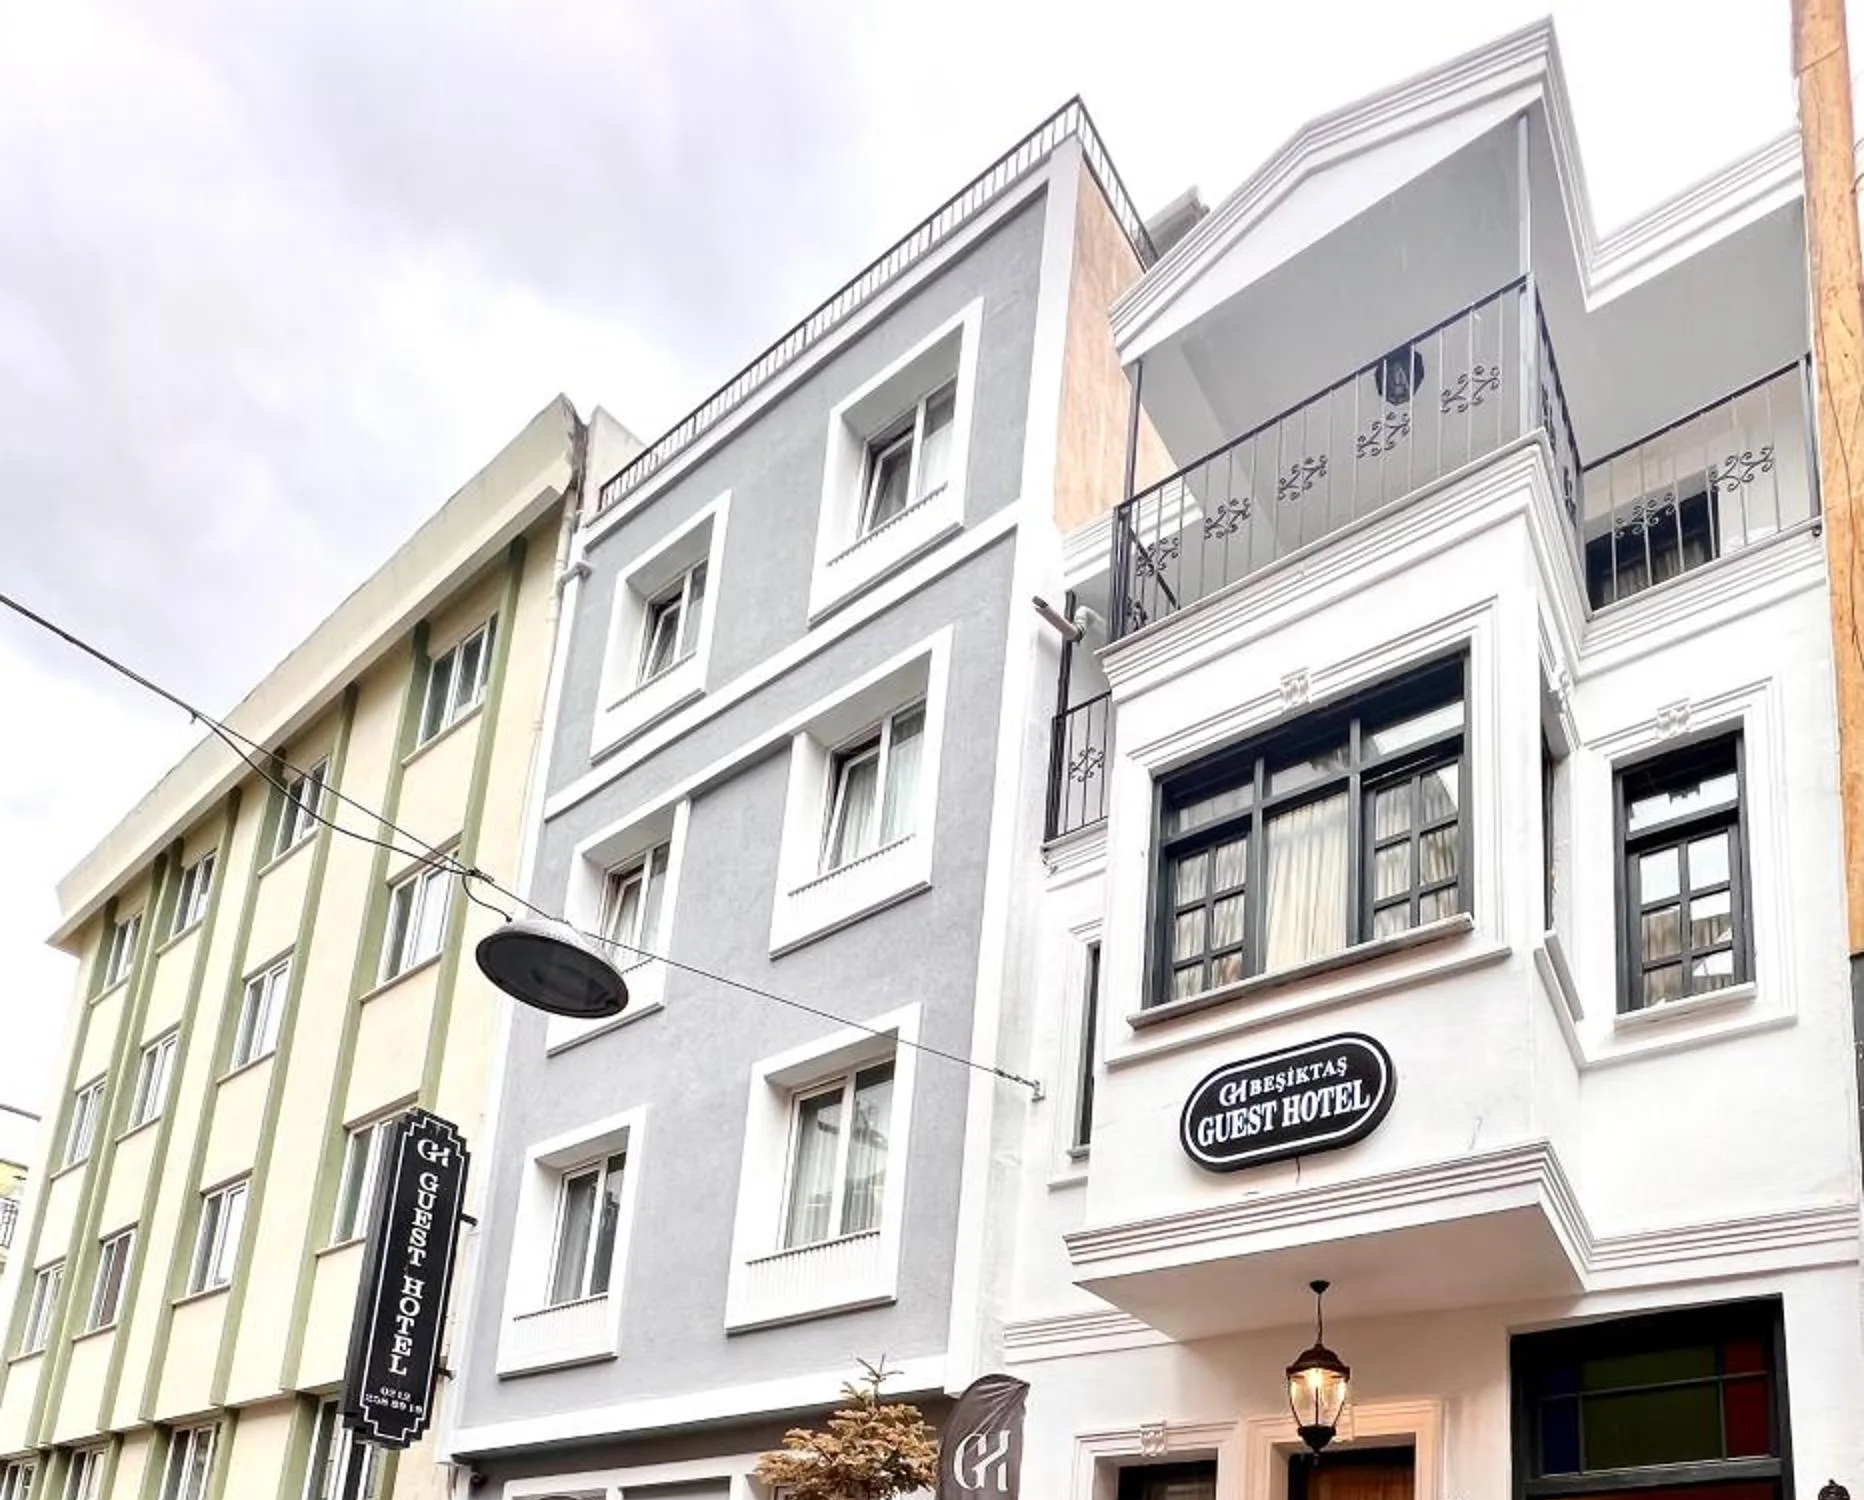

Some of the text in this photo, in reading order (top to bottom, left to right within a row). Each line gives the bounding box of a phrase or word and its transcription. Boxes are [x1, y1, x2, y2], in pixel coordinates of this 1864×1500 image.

[1250, 1055, 1348, 1097] BEŞİKTAŞ
[1197, 1078, 1371, 1147] GUEST HOTEL
[389, 1172, 440, 1376] GUEST HOTEL
